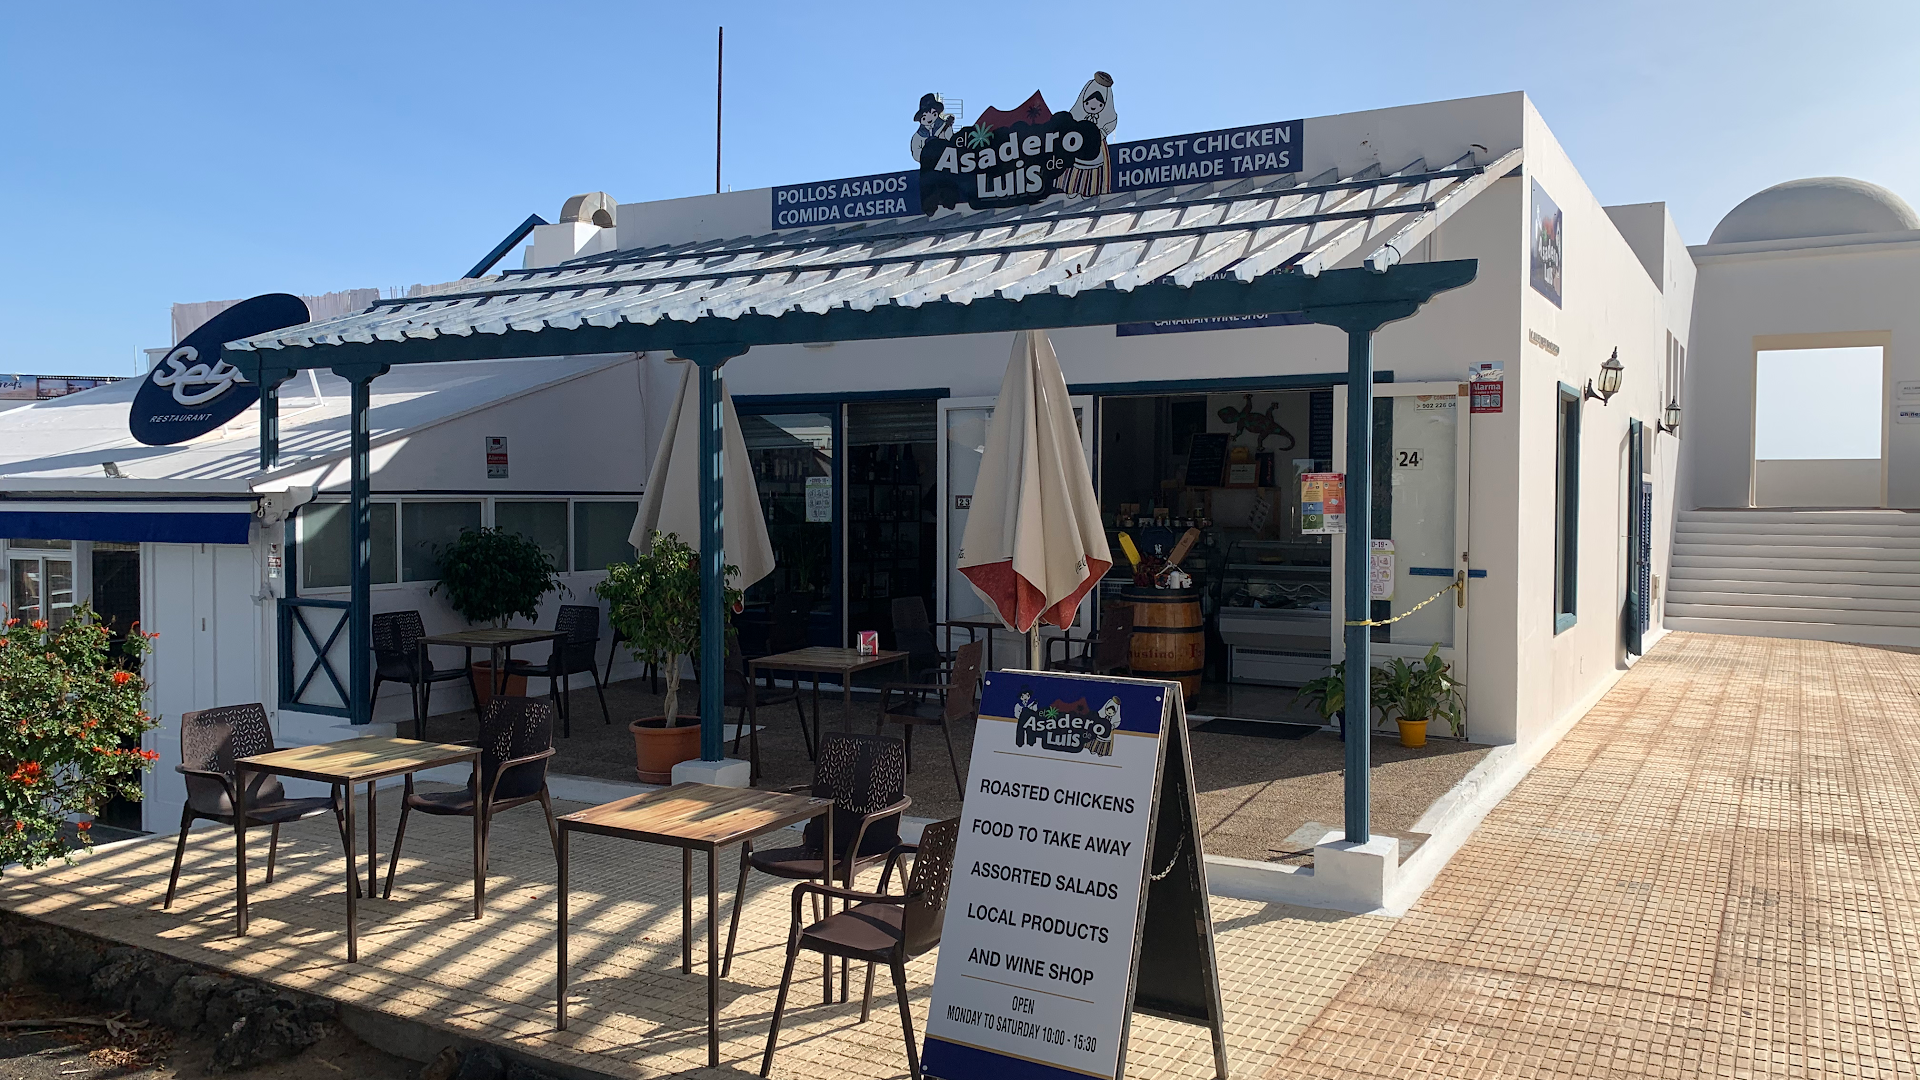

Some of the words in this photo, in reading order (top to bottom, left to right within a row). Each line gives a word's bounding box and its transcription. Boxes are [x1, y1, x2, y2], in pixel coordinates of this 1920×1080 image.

[934, 130, 1084, 175] Asadero
[955, 133, 969, 148] el
[1117, 140, 1189, 165] ROAST
[1193, 126, 1291, 156] CHICKEN
[1046, 154, 1064, 171] de
[1117, 162, 1224, 188] HOMEMADE
[1231, 149, 1290, 173] TAPAS
[777, 187, 837, 206] POLLOS
[840, 175, 908, 199] ASADOS
[975, 164, 1043, 200] Luis
[777, 203, 840, 226] COMIDA
[844, 196, 908, 219] CASERA
[1472, 382, 1501, 391] Alarma
[149, 413, 213, 424] RESTAURANT
[1399, 451, 1419, 467] 24
[1022, 713, 1106, 736] Asadero
[1046, 729, 1081, 748] Luis
[980, 778, 1050, 802] ROASTED
[1053, 788, 1135, 814] CHICKENS
[972, 818, 1014, 839] FOOD
[1018, 825, 1038, 843] TO
[1043, 829, 1082, 852] TAKE
[1084, 836, 1132, 857] AWAY
[970, 860, 1052, 889] ASSORTED
[1055, 875, 1119, 900] SALADS
[967, 902, 1017, 927] LOCAL
[1021, 914, 1109, 944] PRODUCTS
[968, 947, 1001, 968] AND
[1005, 954, 1044, 977] WINE
[1048, 964, 1094, 986] SHOP
[1011, 995, 1035, 1015] OPEN
[946, 1004, 982, 1027] MONDAY
[983, 1012, 994, 1030] TO
[996, 1015, 1041, 1041] SATURDAY
[1043, 1026, 1065, 1046] 10:00
[1073, 1033, 1097, 1053] 15:30
